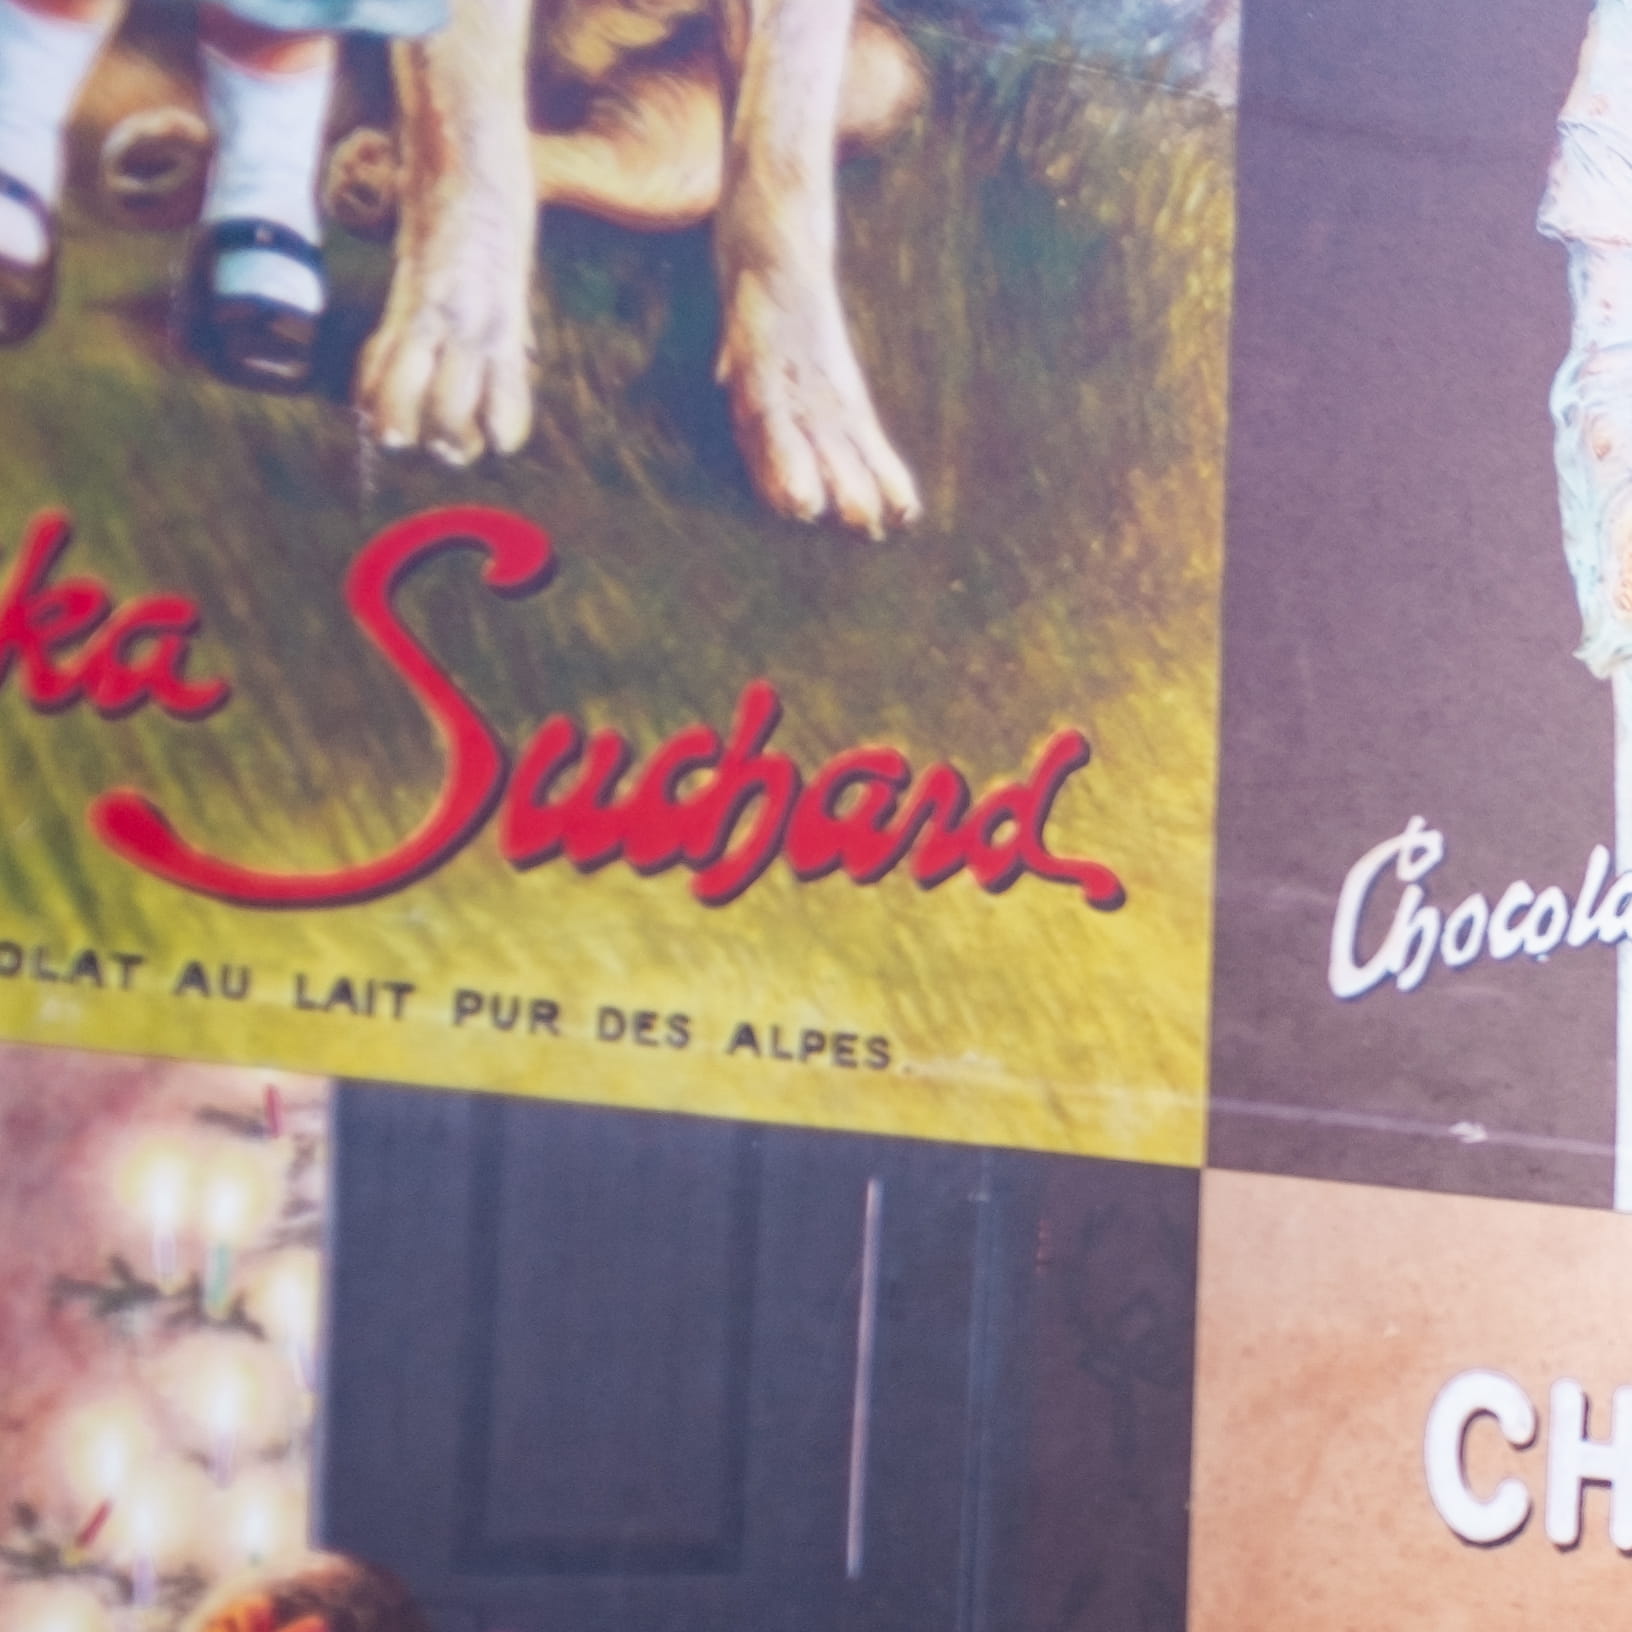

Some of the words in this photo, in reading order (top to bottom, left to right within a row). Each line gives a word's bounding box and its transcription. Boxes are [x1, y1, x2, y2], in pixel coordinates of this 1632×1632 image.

[88, 505, 1126, 910] Suchard
[174, 959, 251, 1000] AU
[293, 972, 414, 1021] LAIT
[451, 989, 561, 1037] PUR
[596, 1005, 692, 1050] DES
